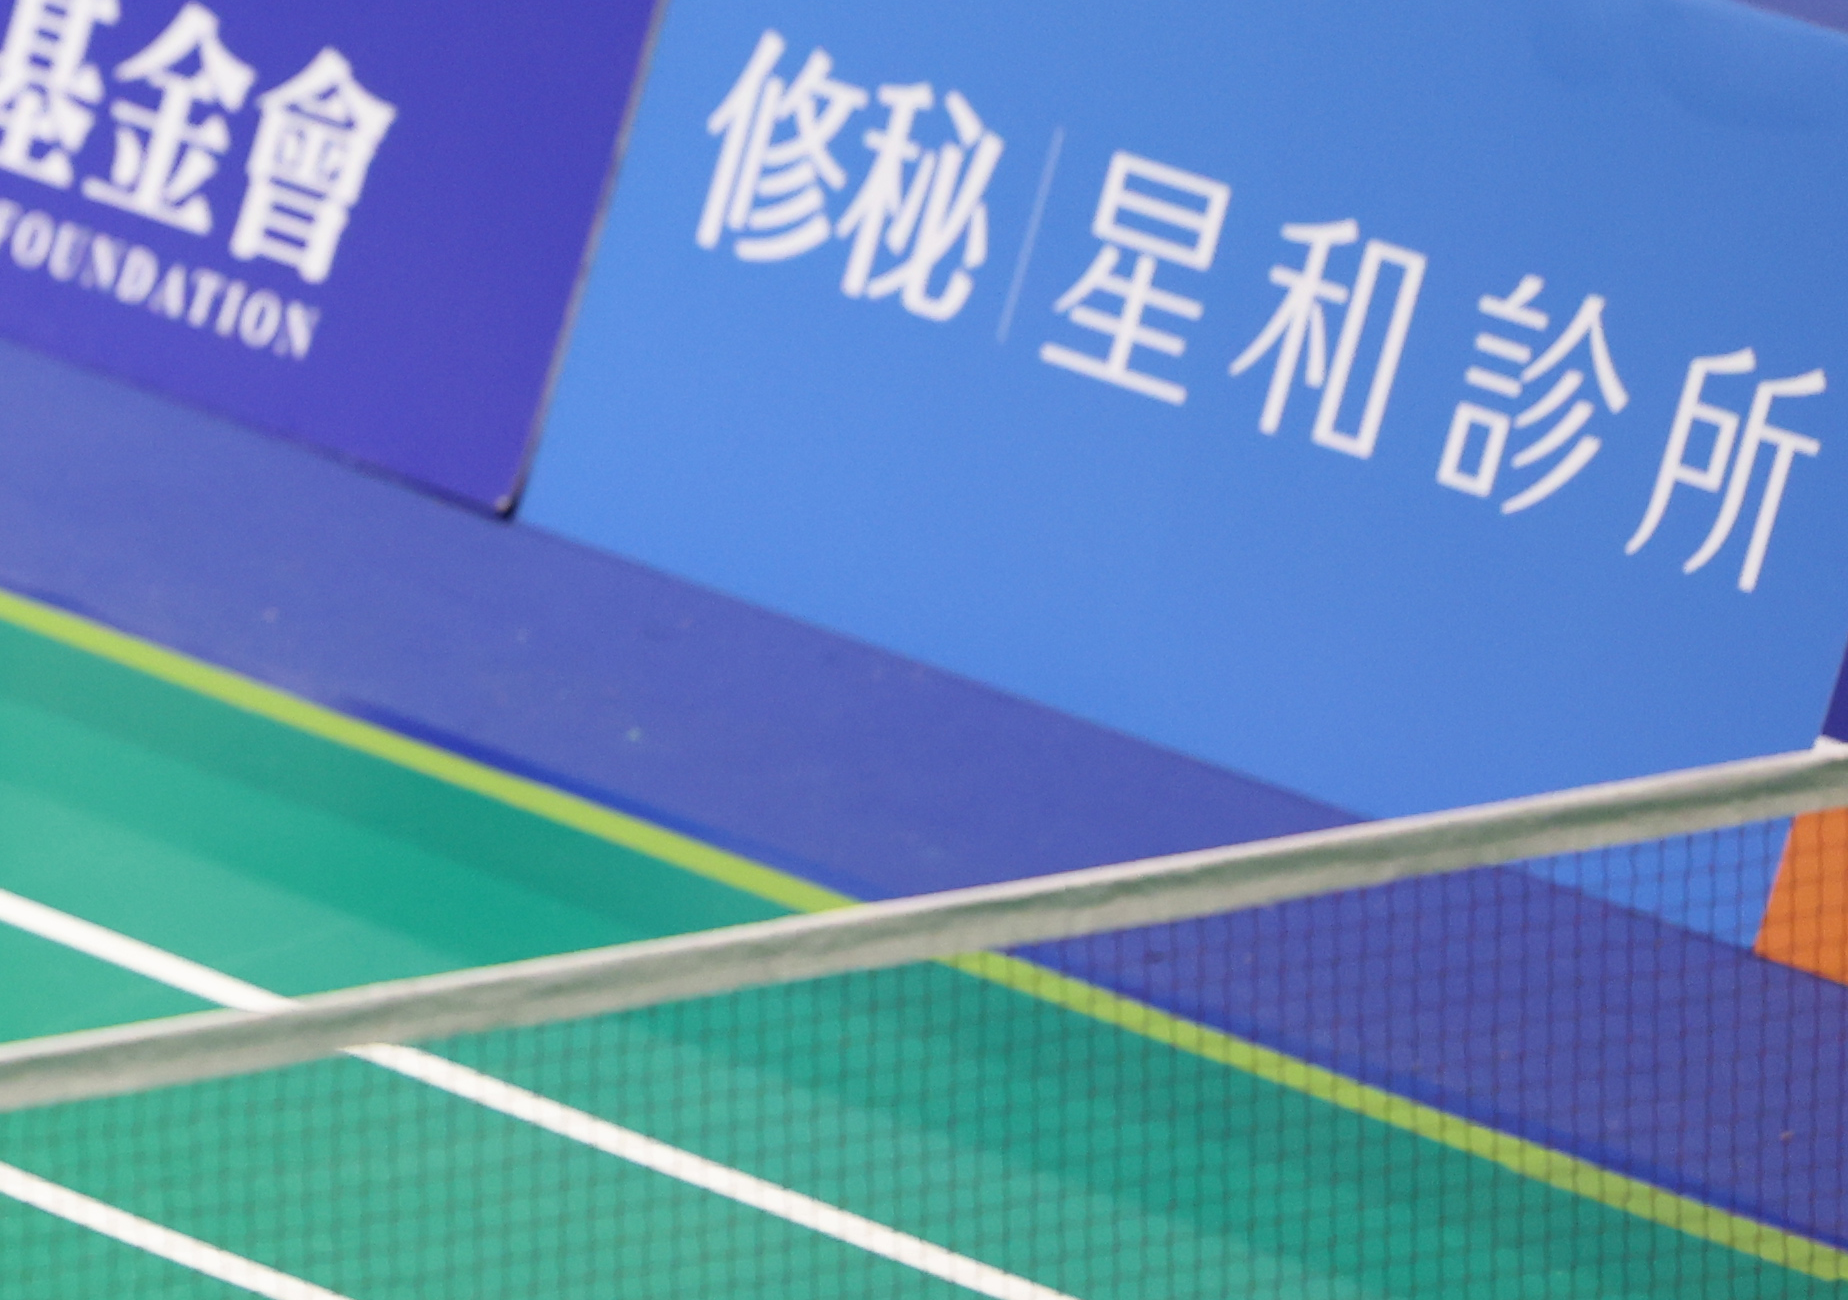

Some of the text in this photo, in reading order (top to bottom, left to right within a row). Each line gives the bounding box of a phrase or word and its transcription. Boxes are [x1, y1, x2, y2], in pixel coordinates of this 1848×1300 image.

[695, 29, 1828, 593] 修秘 星和診所
